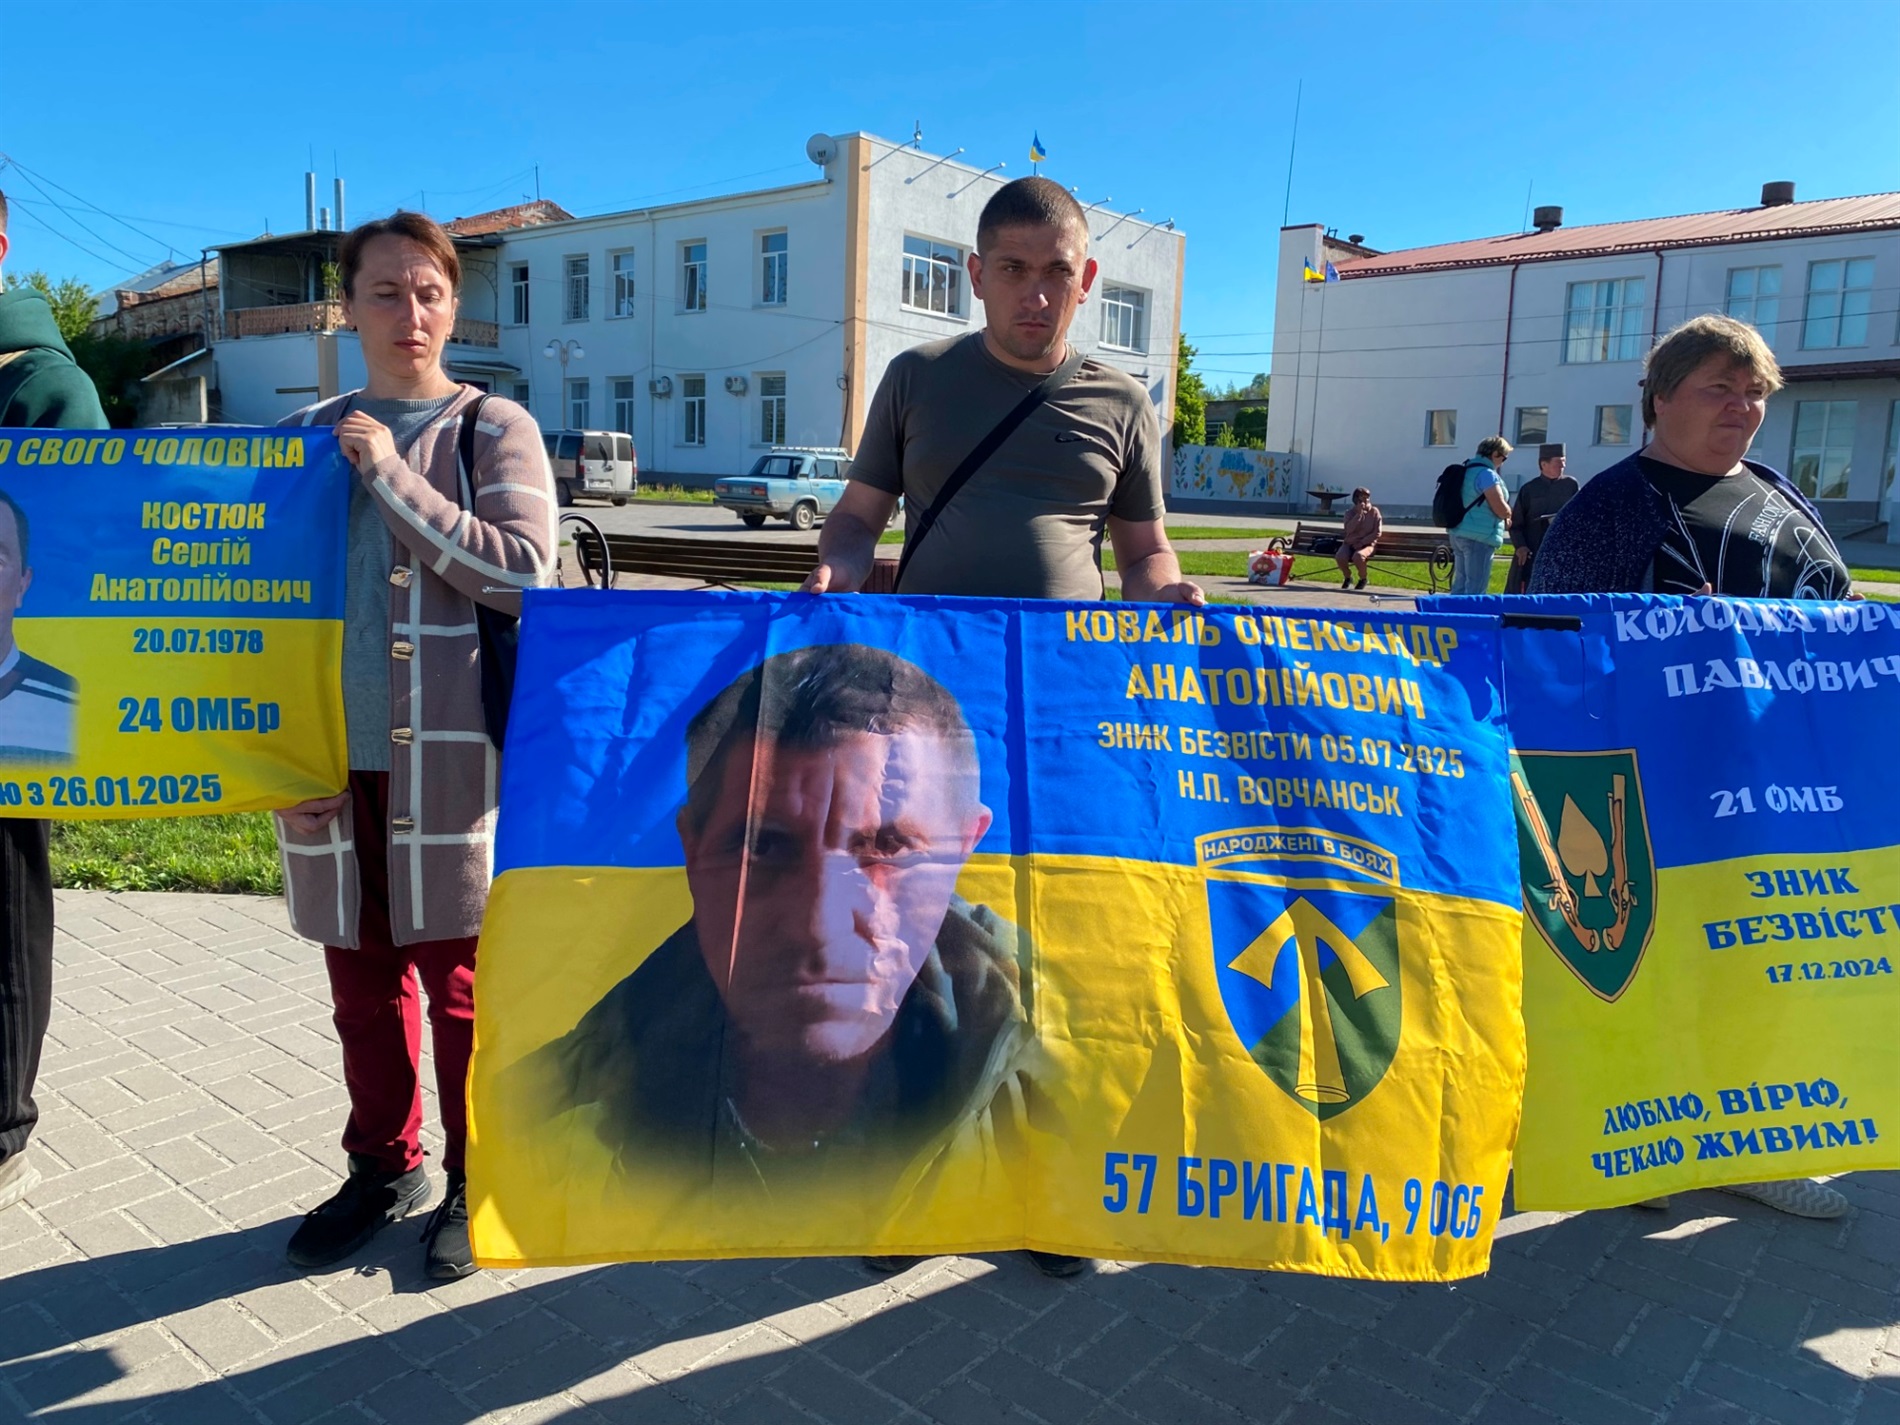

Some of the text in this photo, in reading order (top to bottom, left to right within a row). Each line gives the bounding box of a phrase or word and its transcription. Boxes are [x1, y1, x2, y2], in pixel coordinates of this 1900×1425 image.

[17, 438, 126, 465] СВОГО
[133, 437, 304, 467] ЧОЛОВІКА
[141, 502, 266, 530] КОСТЮК
[1748, 503, 1780, 541] FASHION
[151, 537, 251, 567] Сергій
[90, 572, 312, 604] Анатолійович
[1066, 610, 1458, 668] КОВАЛЬ ОЛЕКСАНДР
[1614, 598, 1817, 642] КОЛОДКА
[133, 628, 264, 655] 20.07.1978
[1126, 661, 1426, 719] АНАТОЛІЙОВИЧ
[1662, 655, 1900, 697] ПАВЛОВИЧ
[118, 697, 280, 734] 24 ОМБр
[1097, 722, 1465, 779] ЗНИК БЕЗВІСТИ 05.07.2025
[48, 773, 223, 807] 26.01.2025
[1177, 770, 1403, 817] Н.П. ВОВЧАНСЬК
[1710, 783, 1844, 818] 21 ОМБ
[1204, 835, 1392, 876] НАРОДЖЕНІ В БОЯХ
[1744, 867, 1860, 899] ЗНИК
[1765, 956, 1893, 984] 17.12.2024
[1603, 1092, 1711, 1135] ЛЮБЛЮ,
[1591, 1118, 1879, 1178] ЧЕКАЮ ЖИВИМ!
[1102, 1152, 1484, 1245] 57 БРИГАДА, 9 ОСБ
